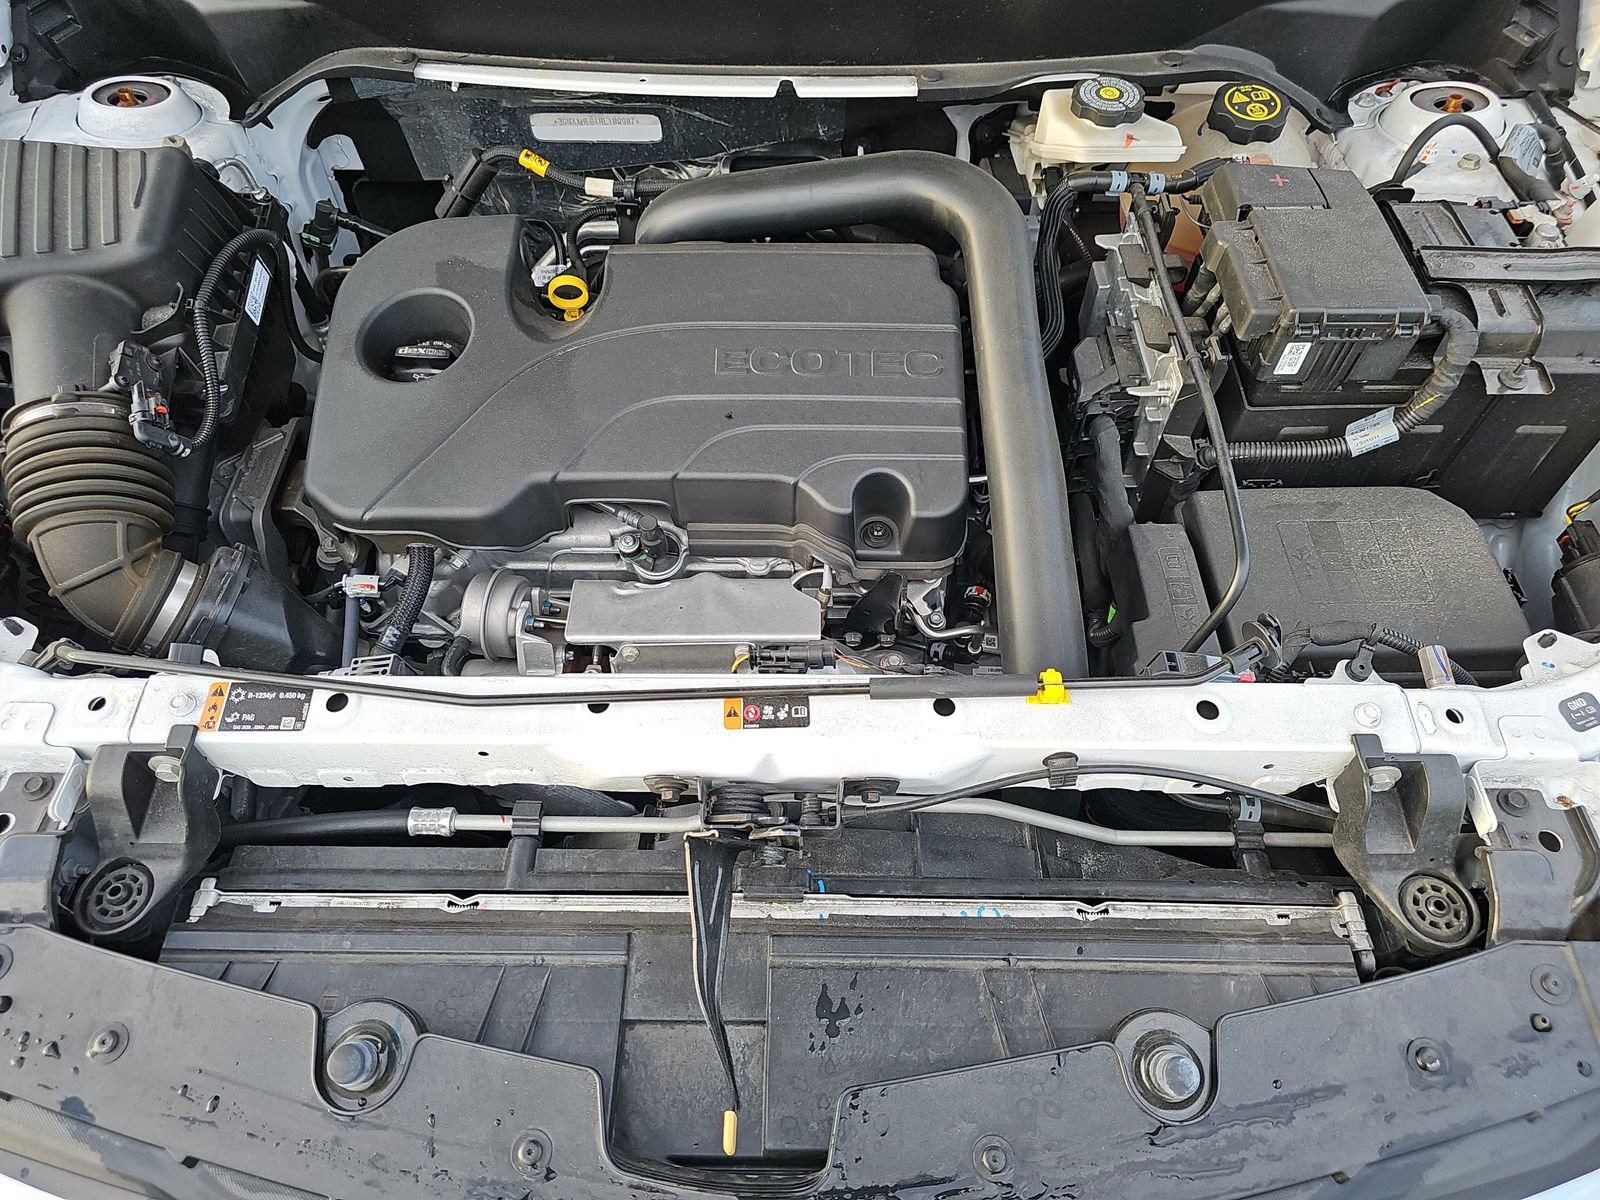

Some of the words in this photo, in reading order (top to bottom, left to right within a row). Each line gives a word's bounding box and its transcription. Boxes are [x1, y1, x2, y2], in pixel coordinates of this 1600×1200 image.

[397, 346, 447, 356] dexos
[714, 348, 944, 379] ECOTEC
[247, 691, 277, 700] R-1234yf
[279, 691, 297, 699] 0.450
[297, 691, 306, 700] kg
[1567, 697, 1586, 710] GND
[241, 713, 255, 721] PAG
